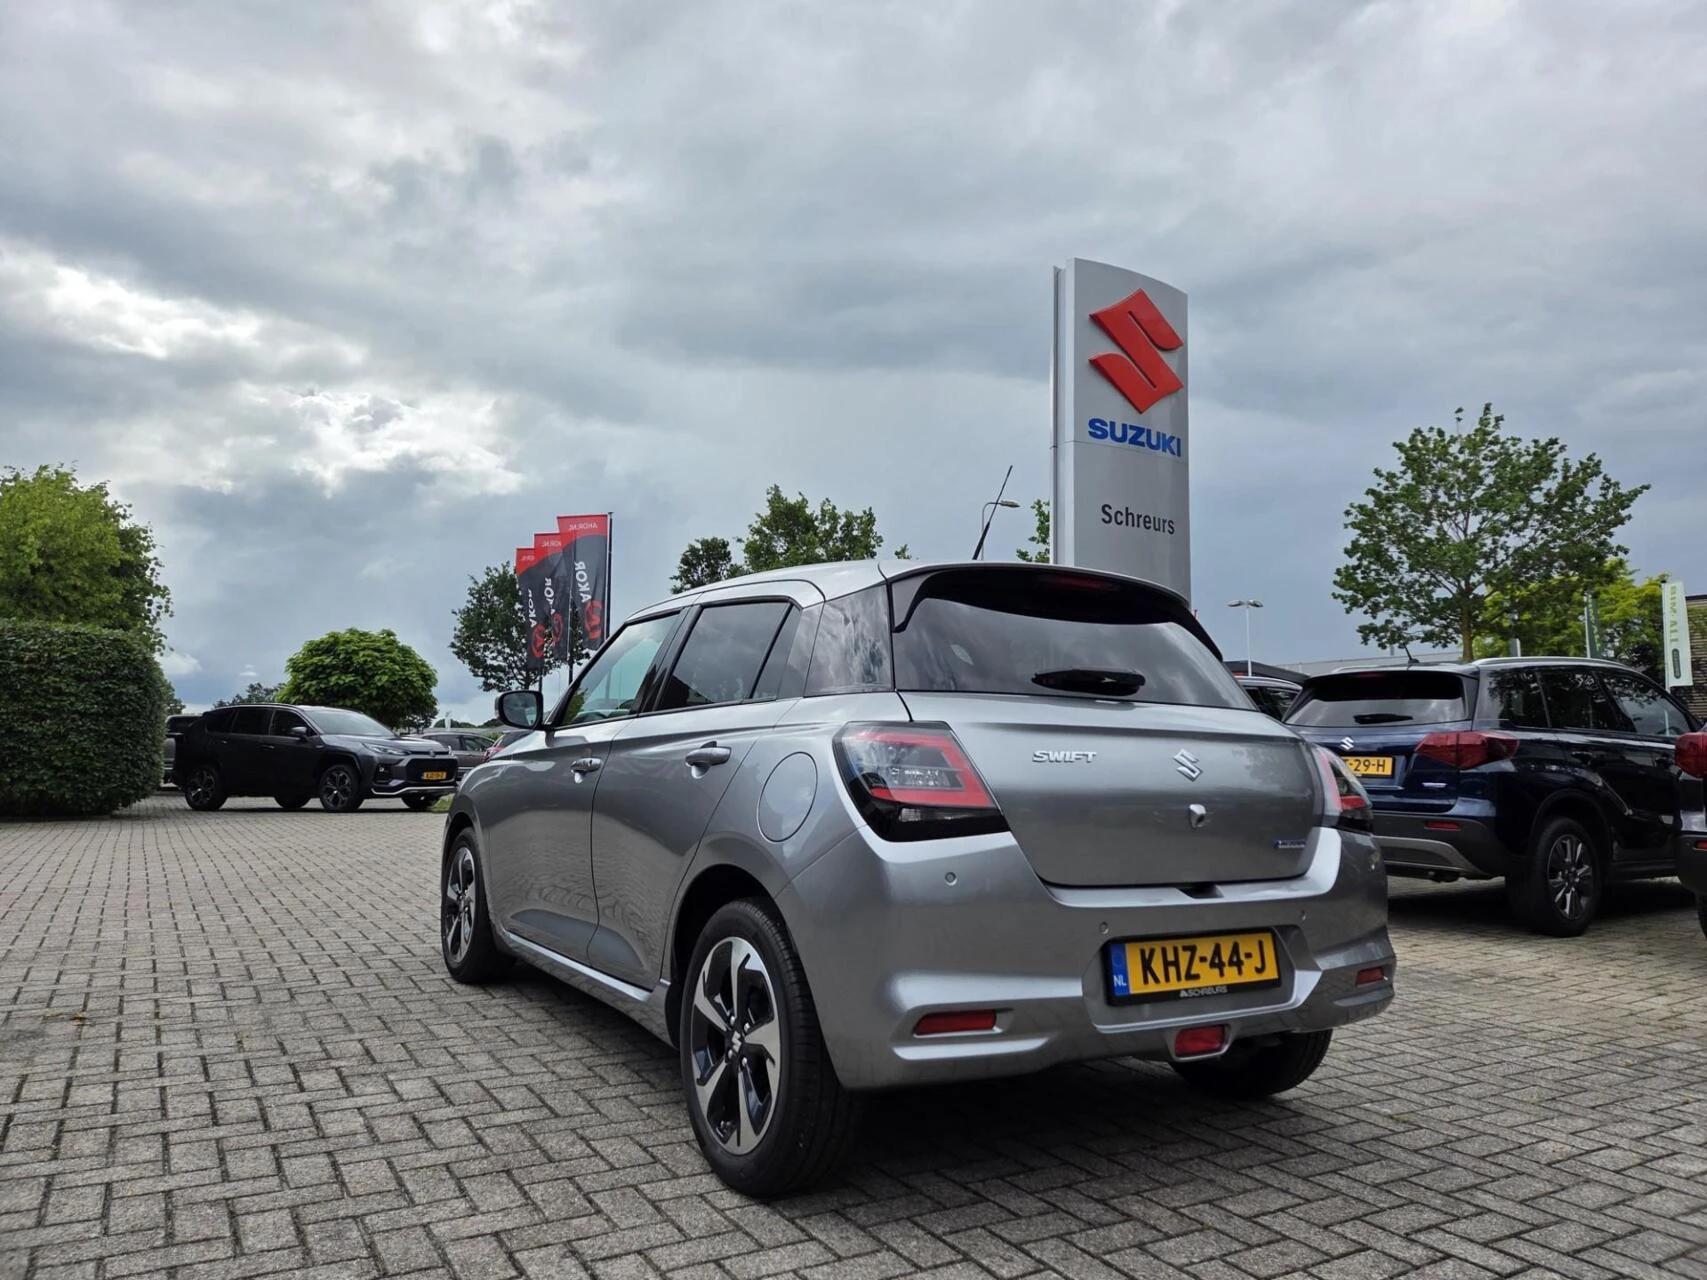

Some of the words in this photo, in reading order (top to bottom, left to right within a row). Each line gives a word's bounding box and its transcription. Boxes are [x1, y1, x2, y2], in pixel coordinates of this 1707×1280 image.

[1088, 418, 1181, 457] SUZUKI
[1101, 504, 1175, 534] Schreurs
[1032, 750, 1097, 763] SWIFT
[1343, 758, 1386, 773] -29-H
[1139, 939, 1267, 985] KHZ-44-J
[1113, 974, 1127, 987] NL
